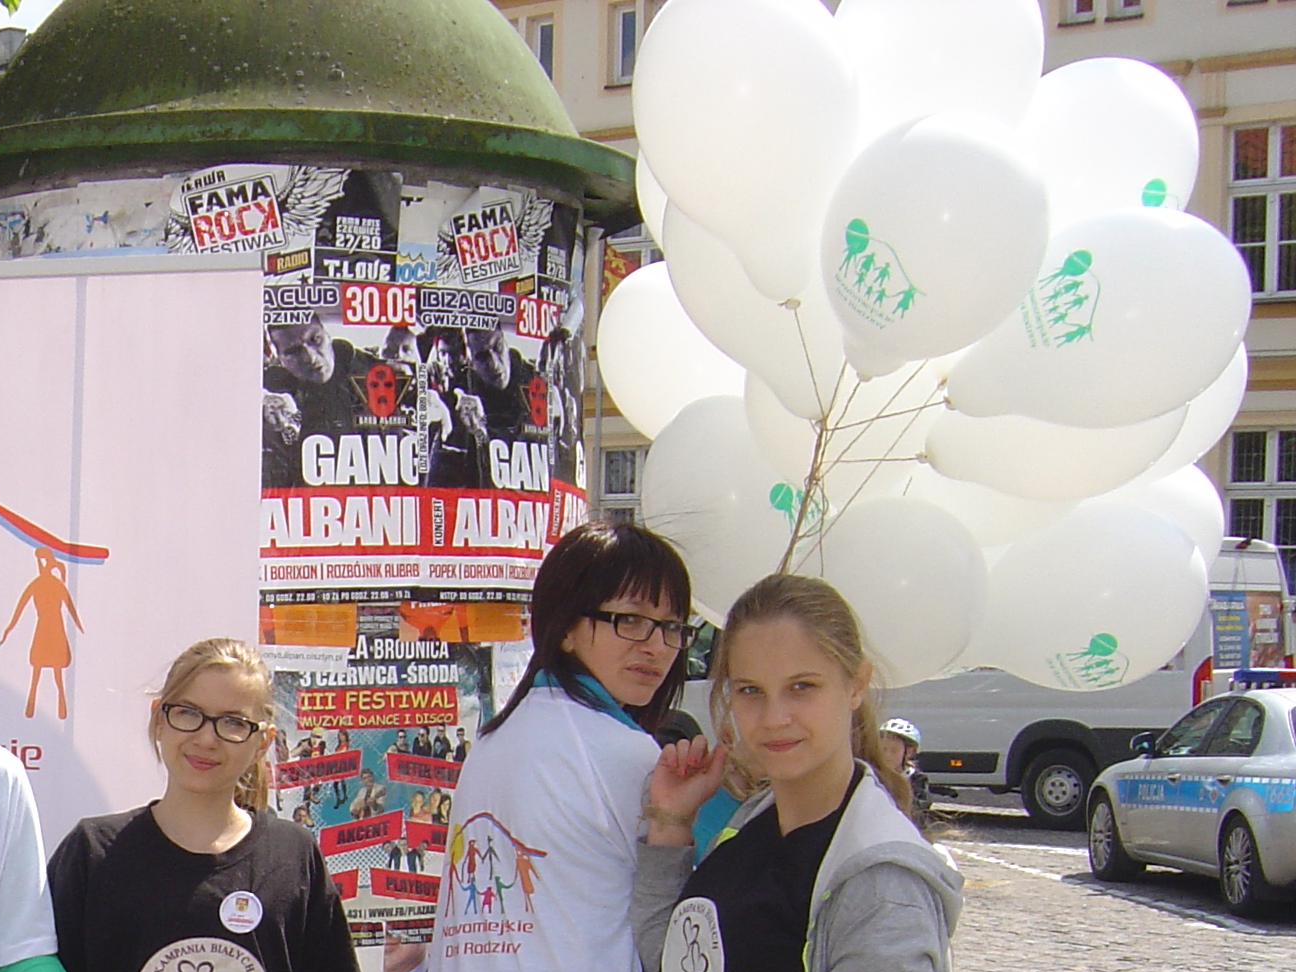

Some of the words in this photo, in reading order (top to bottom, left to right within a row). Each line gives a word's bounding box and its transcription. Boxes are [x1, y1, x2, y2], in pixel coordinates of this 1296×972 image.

[187, 179, 272, 215] FAMA
[193, 199, 280, 247] ROCK
[453, 203, 512, 234] FAMA
[199, 231, 283, 254] FESTIWAL
[457, 224, 518, 267] ROCK
[277, 251, 309, 271] RADIO
[463, 256, 520, 280] FESTIWAL
[278, 285, 340, 307] CLUB
[345, 286, 416, 324] 30.05
[422, 289, 471, 310] IBIZA
[474, 293, 516, 316] CLUB
[261, 496, 420, 548] ALBANI
[433, 499, 444, 546] KONCERT
[270, 564, 317, 580] BORIXON
[327, 561, 382, 579] ROZBÓJNIK
[429, 563, 457, 579] POPEK
[464, 564, 504, 579] BORIXON
[374, 637, 449, 660] BRODNICA
[316, 664, 397, 686] CZERWCA
[300, 691, 337, 711] III
[345, 690, 456, 711] FESTIWAL
[300, 714, 353, 728] MUZYKI
[358, 713, 400, 727] DANCE
[405, 714, 411, 725] I
[415, 712, 454, 725] DISCO
[336, 820, 390, 846] AKCENT
